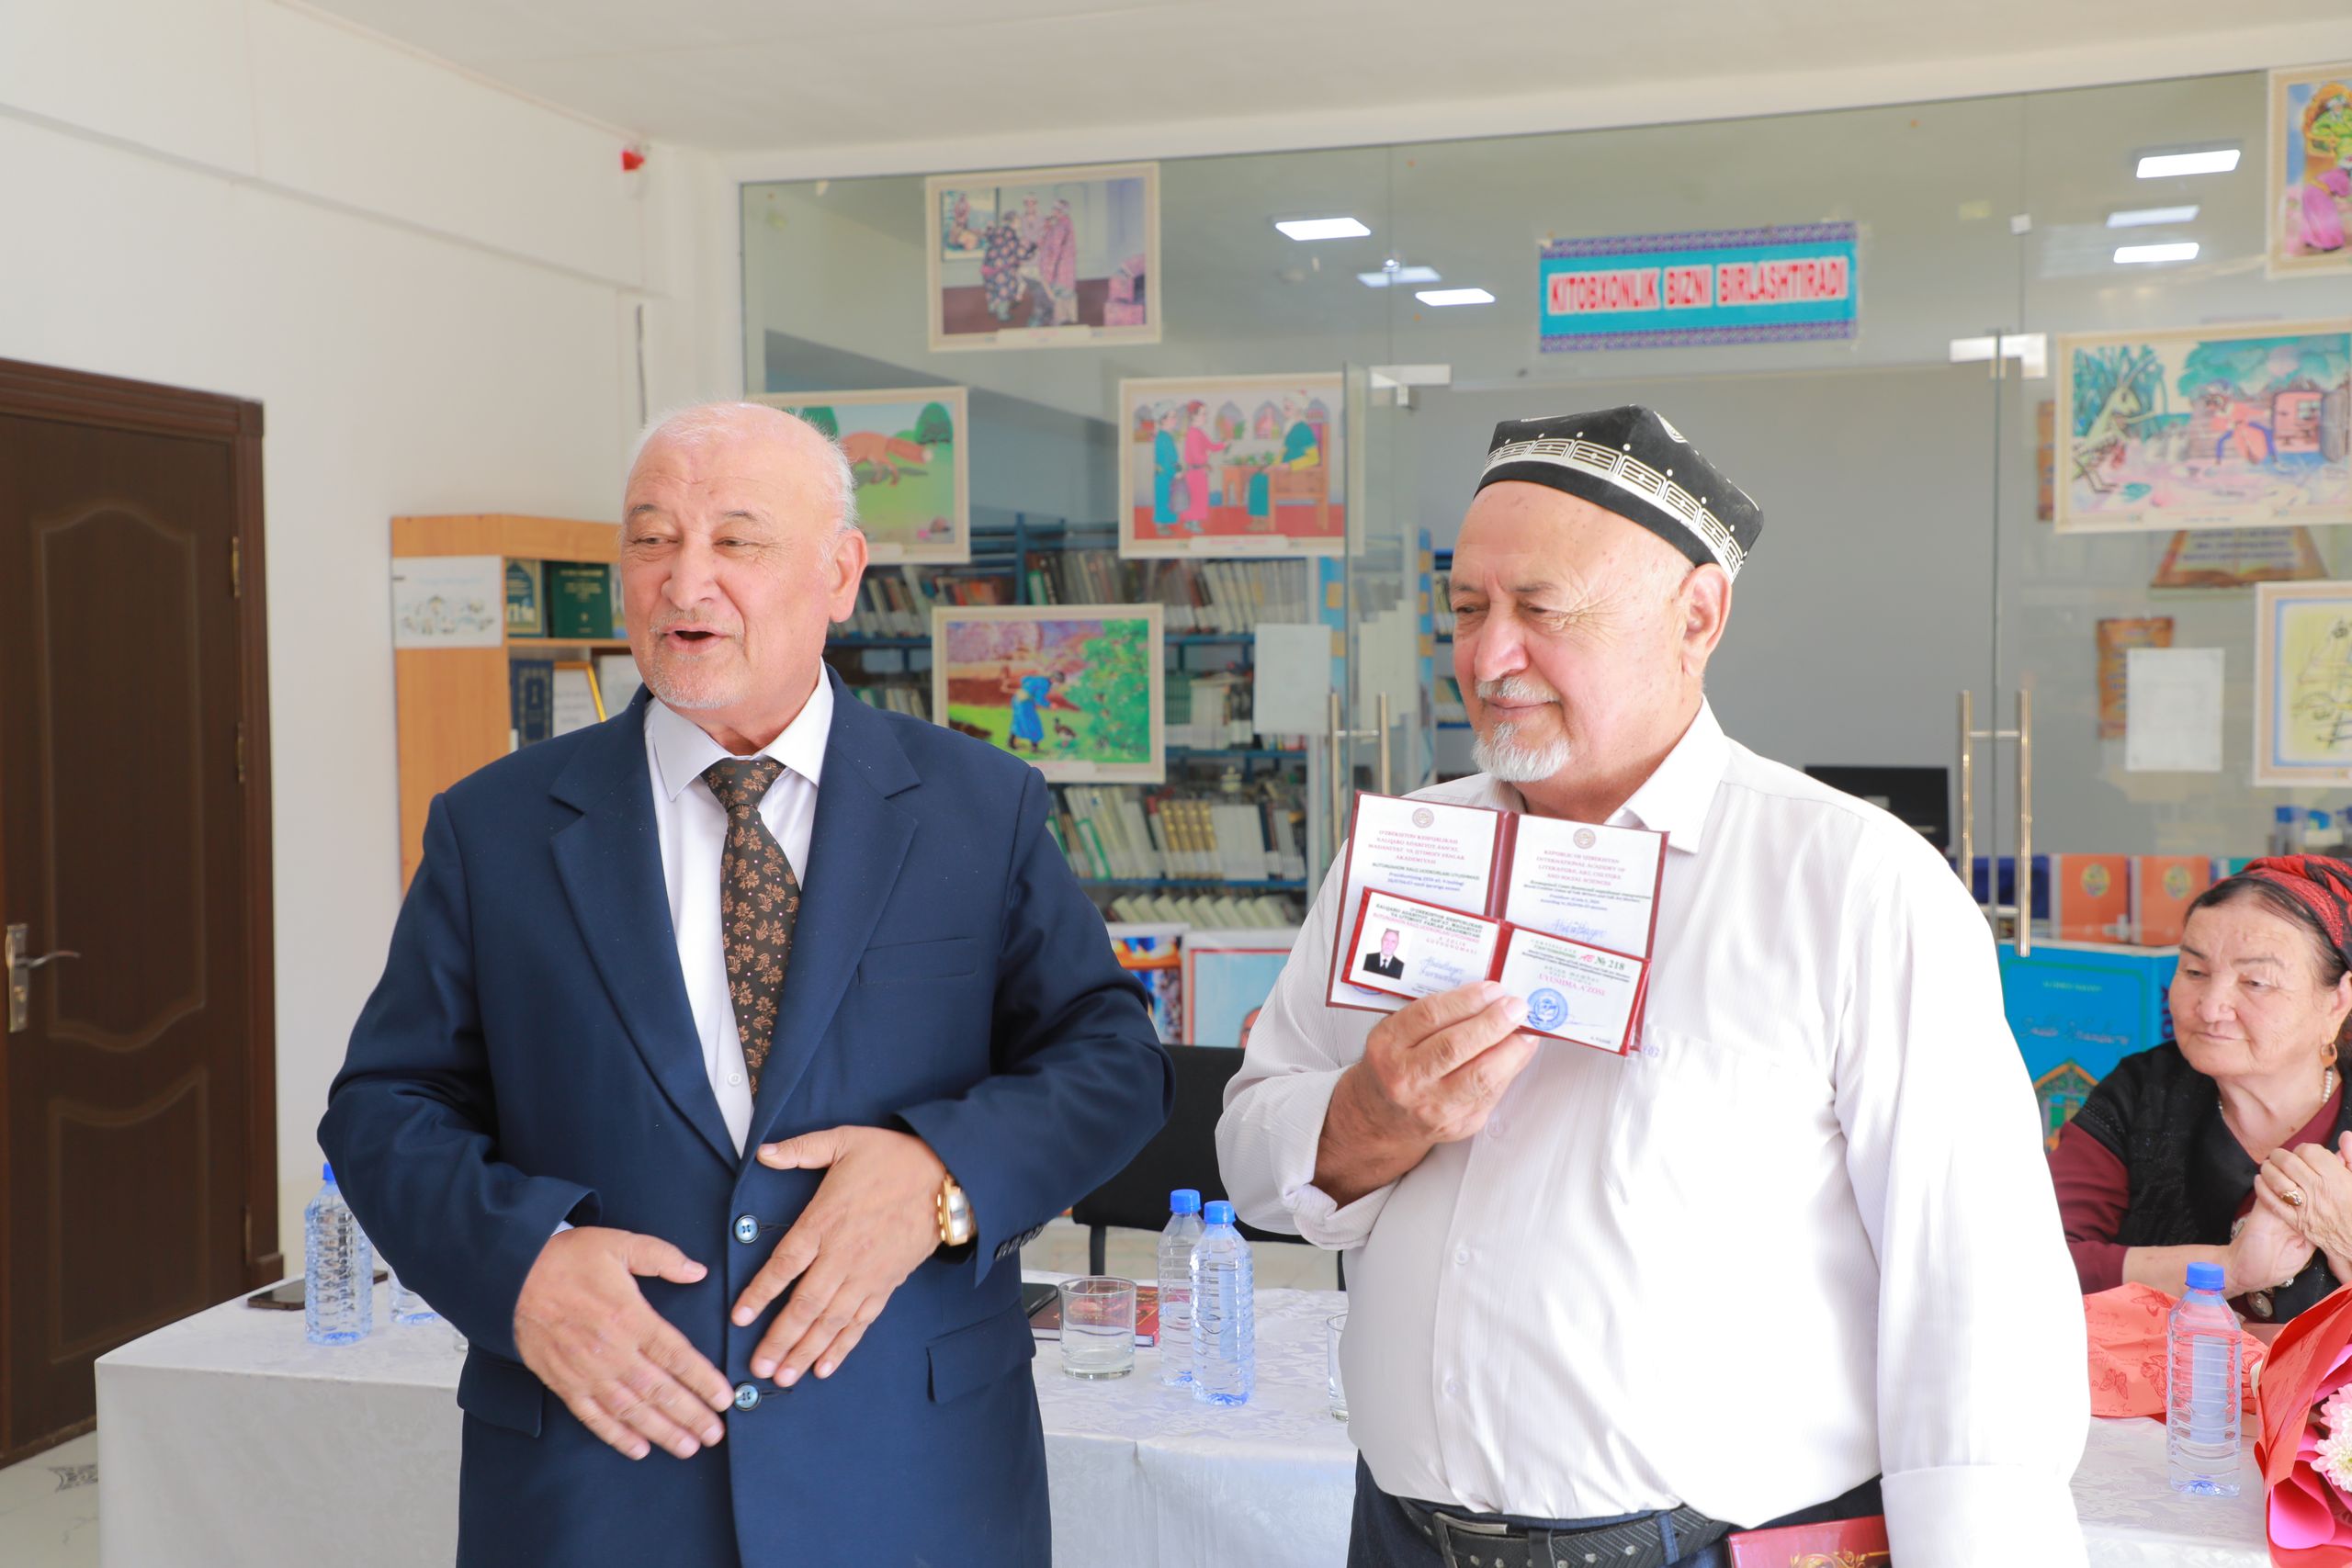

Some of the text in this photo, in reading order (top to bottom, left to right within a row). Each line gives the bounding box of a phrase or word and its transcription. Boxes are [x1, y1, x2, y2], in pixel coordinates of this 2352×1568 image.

[1549, 256, 1848, 314] KITOBXONLIK BIZNI BIRLASHTIRADI
[1608, 959, 1625, 971] 218
